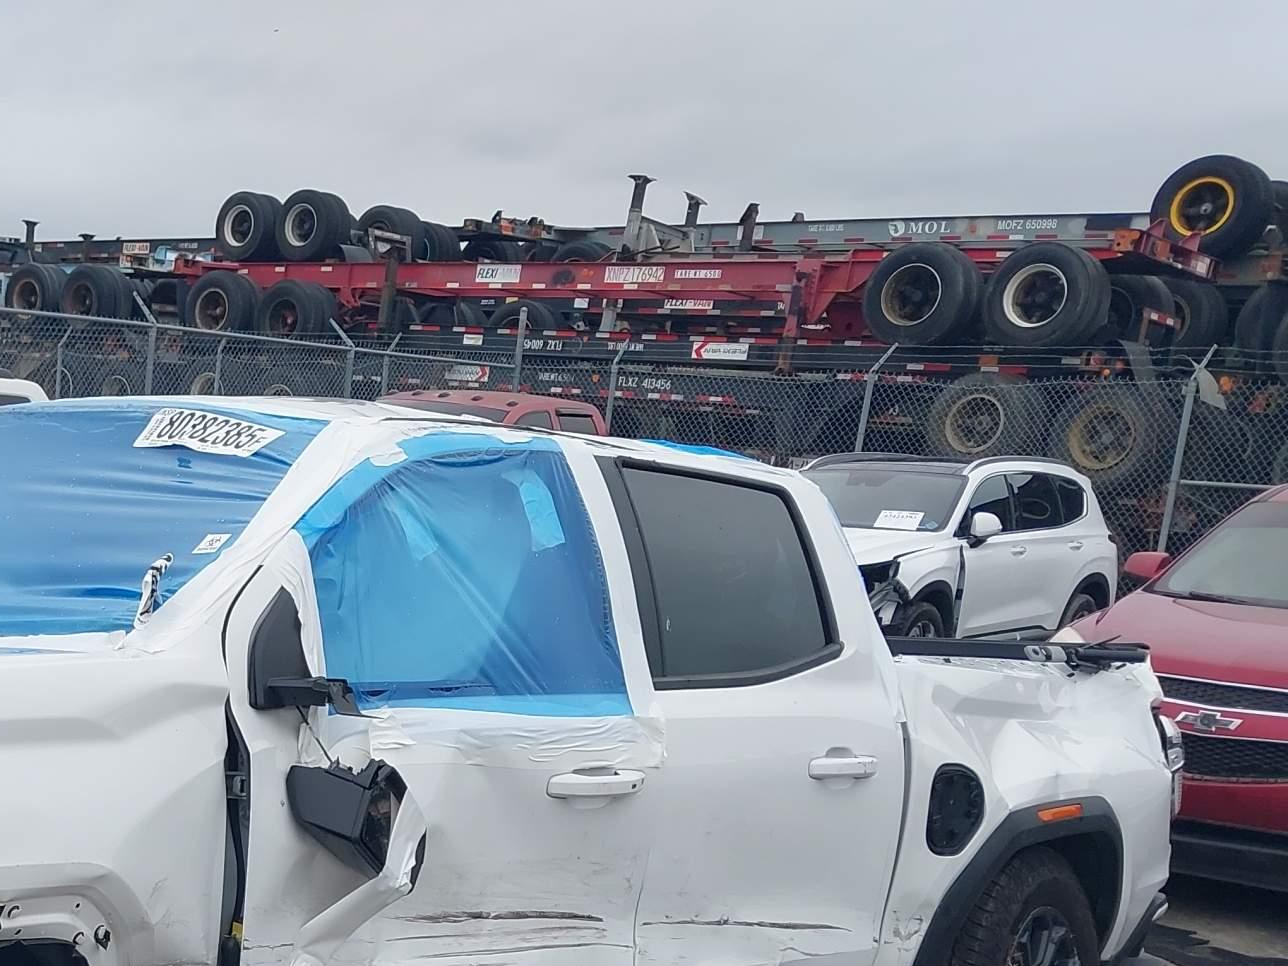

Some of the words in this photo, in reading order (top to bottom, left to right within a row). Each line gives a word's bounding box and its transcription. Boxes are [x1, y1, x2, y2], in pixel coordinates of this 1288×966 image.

[908, 221, 951, 233] MOL
[997, 219, 1024, 230] MOFZ
[1025, 218, 1058, 229] 650998
[477, 267, 499, 279] FLEXI
[618, 376, 639, 388] FLXZ
[642, 378, 671, 390] 413456
